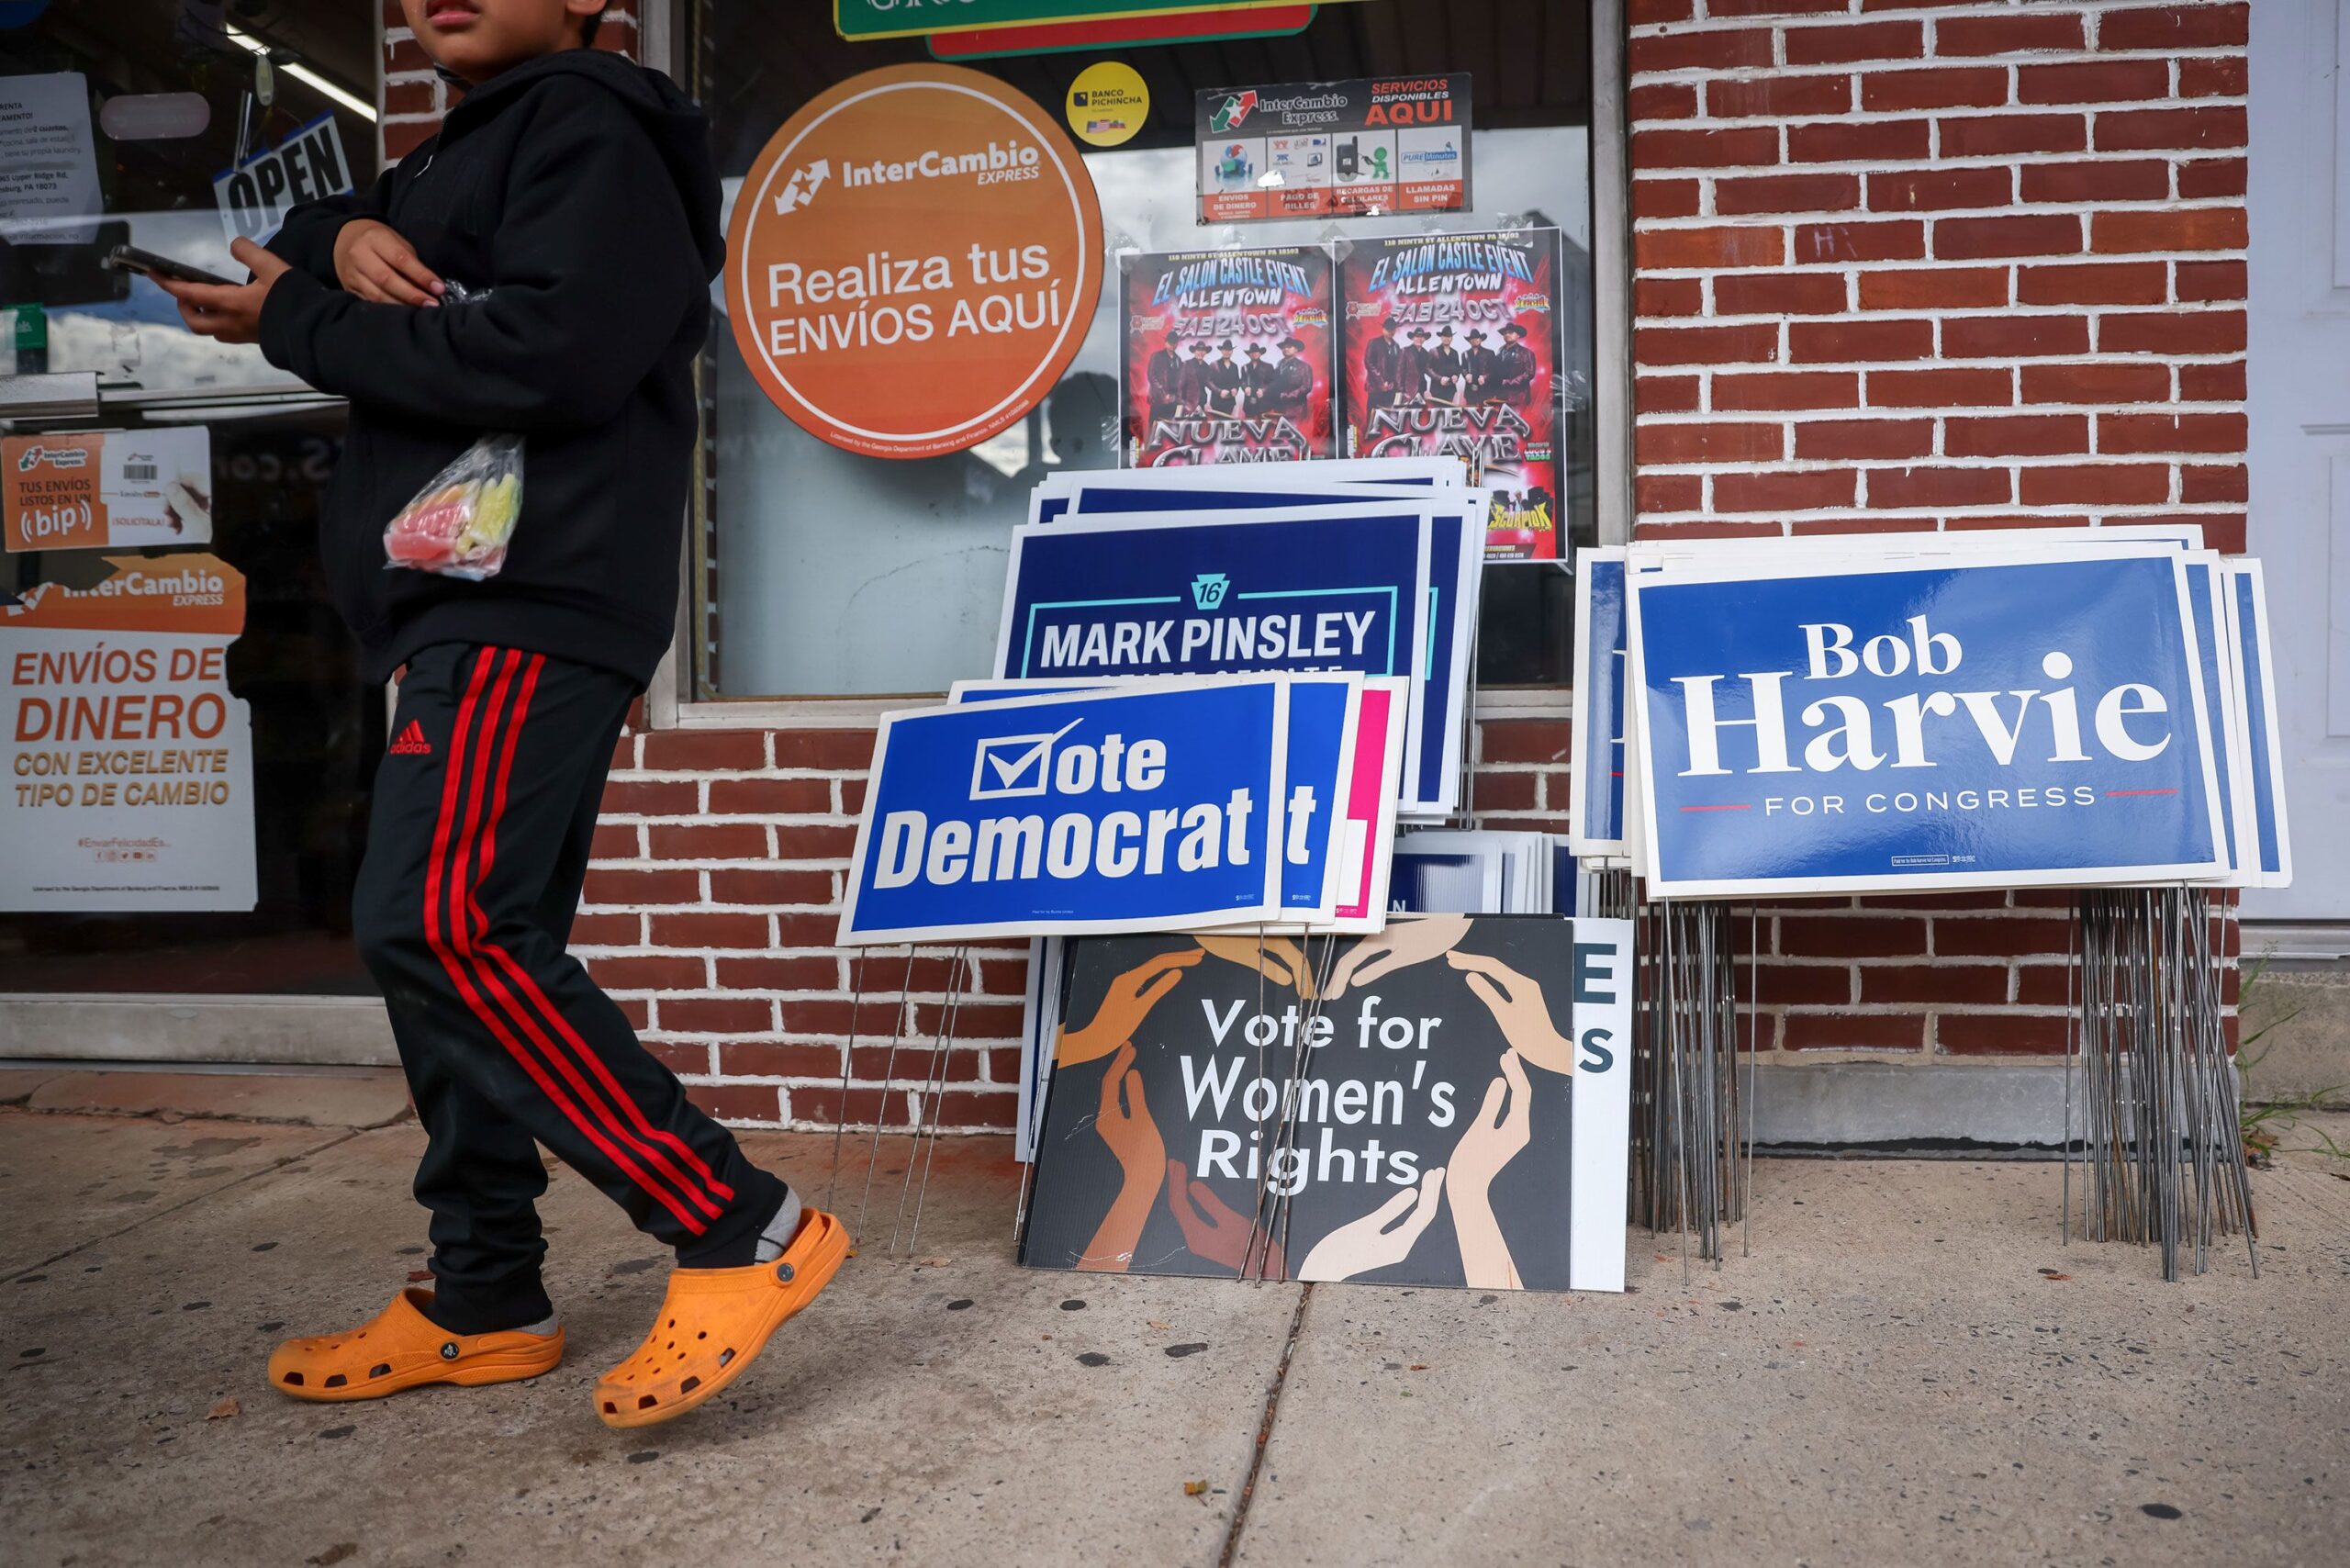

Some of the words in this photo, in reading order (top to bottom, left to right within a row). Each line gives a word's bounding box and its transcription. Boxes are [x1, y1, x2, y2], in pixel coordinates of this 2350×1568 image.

[1091, 89, 1124, 97] BANCO
[1371, 79, 1448, 95] SERVICIOS
[1371, 91, 1449, 104] DISPONIBLES
[1091, 96, 1142, 106] PICHINCHA
[1259, 93, 1348, 113] InterCambio
[1364, 99, 1453, 126] AQUI
[843, 140, 1040, 187] InterCambio
[978, 166, 1040, 185] EXPRESS
[228, 125, 345, 239] OPEN
[1382, 185, 1393, 193] DE
[1405, 185, 1455, 194] LLAMADAS
[1218, 194, 1249, 202] ENVIOS
[1226, 202, 1257, 210] DINERO
[1307, 192, 1320, 200] DE
[1431, 194, 1448, 202] PIN
[1437, 234, 1486, 243] ALLENTOWN
[1218, 250, 1266, 258] ALLENTOWN
[768, 252, 954, 308] Realiza
[968, 243, 1050, 283] tus
[1367, 257, 1391, 294] EL
[1392, 244, 1436, 282] SALON
[1438, 241, 1484, 271] CASTLE
[1484, 243, 1535, 284] EVENT
[1151, 271, 1174, 308] EL
[1175, 259, 1215, 296] SALON
[1219, 257, 1265, 286] CASTLE
[1265, 259, 1313, 298] EVENT
[1394, 273, 1503, 295] ALLENTOWN
[1178, 287, 1282, 309] ALLENTOWN
[1434, 298, 1465, 321] 24
[1466, 297, 1509, 319] OCT
[770, 300, 934, 356] ENVÍOS
[947, 278, 1060, 338] AQUÍ
[1215, 313, 1245, 337] 24
[1246, 312, 1288, 334] OCT
[1150, 416, 1307, 448] NUEVA
[1367, 403, 1530, 437] NUEVA
[44, 450, 87, 460] InterCambio
[19, 482, 42, 493] TUS
[46, 478, 91, 492] ENVÍOS
[19, 495, 54, 506] LISTOS
[57, 495, 72, 505] EN
[75, 493, 92, 504] UN
[63, 569, 224, 598] erCambio
[1199, 581, 1223, 603] 16
[173, 593, 224, 606] EXPRESS
[1040, 620, 1176, 667] MARK
[1180, 610, 1376, 662] PINSLEY
[1798, 614, 1963, 681] Bob
[12, 642, 157, 686] ENVÍOS
[169, 647, 224, 681] DE
[14, 693, 227, 742] DINERO
[1670, 651, 2173, 777] Harvie
[389, 742, 431, 755] adidas
[14, 751, 69, 776] CON
[77, 748, 229, 775] EXCELENTE
[15, 782, 73, 808] TIPO
[81, 781, 118, 807] DE
[123, 779, 229, 806] CAMBIO
[1765, 794, 1845, 817] FOR
[1865, 786, 2097, 814] CONGRESS
[873, 787, 1254, 890] Democrat
[1201, 999, 1334, 1049] Vote
[1358, 995, 1441, 1050] for
[1181, 1054, 1456, 1129] Women's
[1196, 1129, 1420, 1196] Rights
